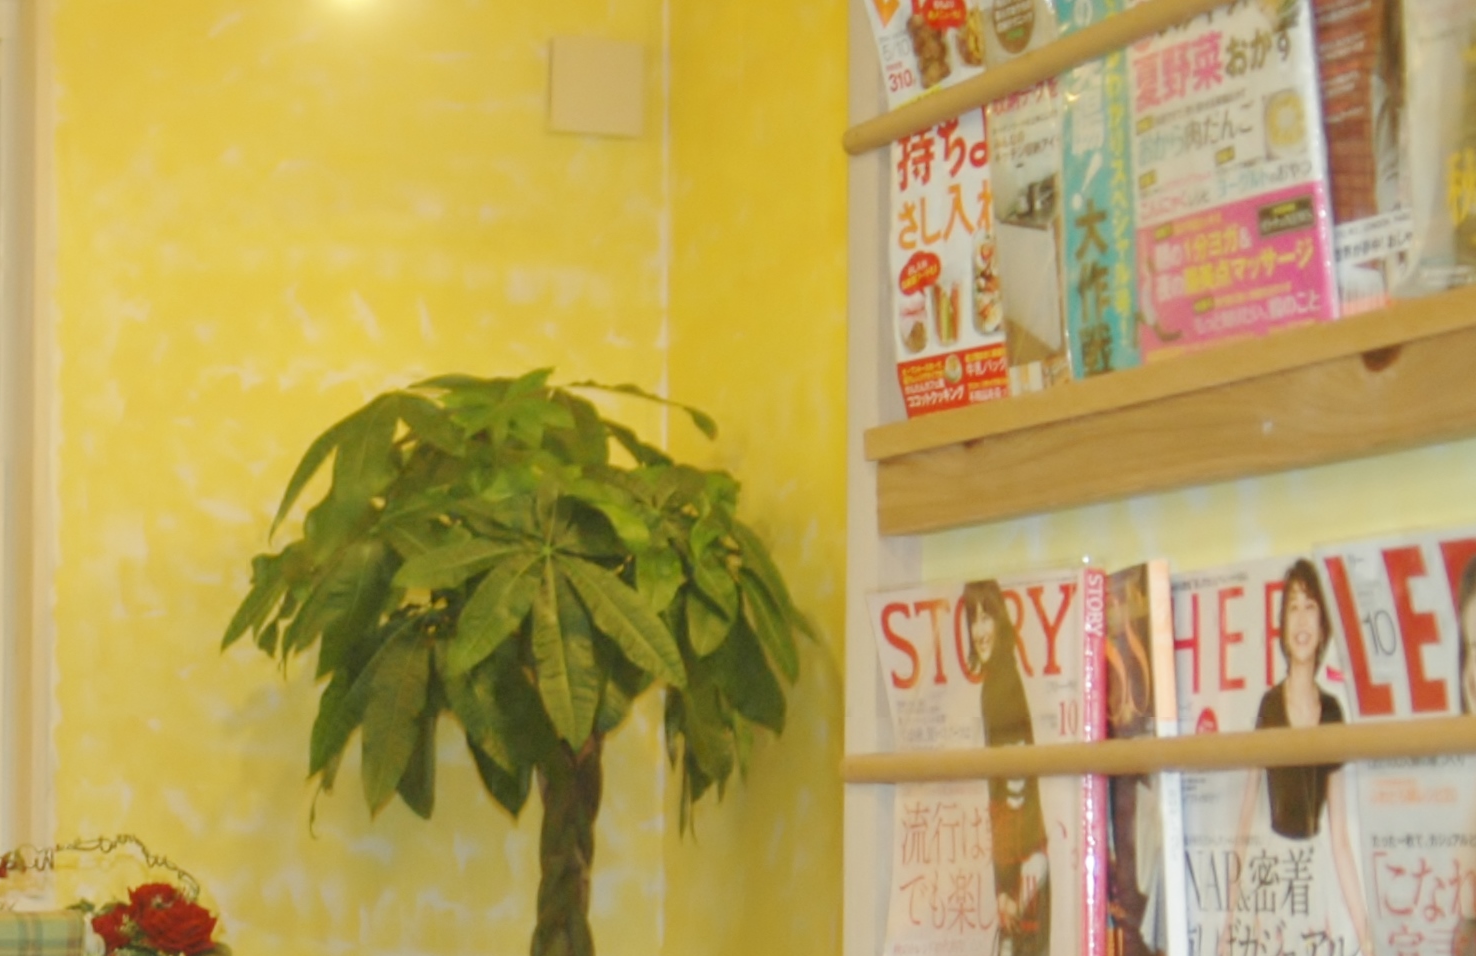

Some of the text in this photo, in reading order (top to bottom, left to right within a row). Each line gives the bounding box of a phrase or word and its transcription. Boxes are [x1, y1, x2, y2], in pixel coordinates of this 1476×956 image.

[889, 69, 912, 92] 310
[1087, 573, 1104, 638] STORY
[880, 583, 1078, 690] STORY
[1059, 701, 1078, 737] 10
